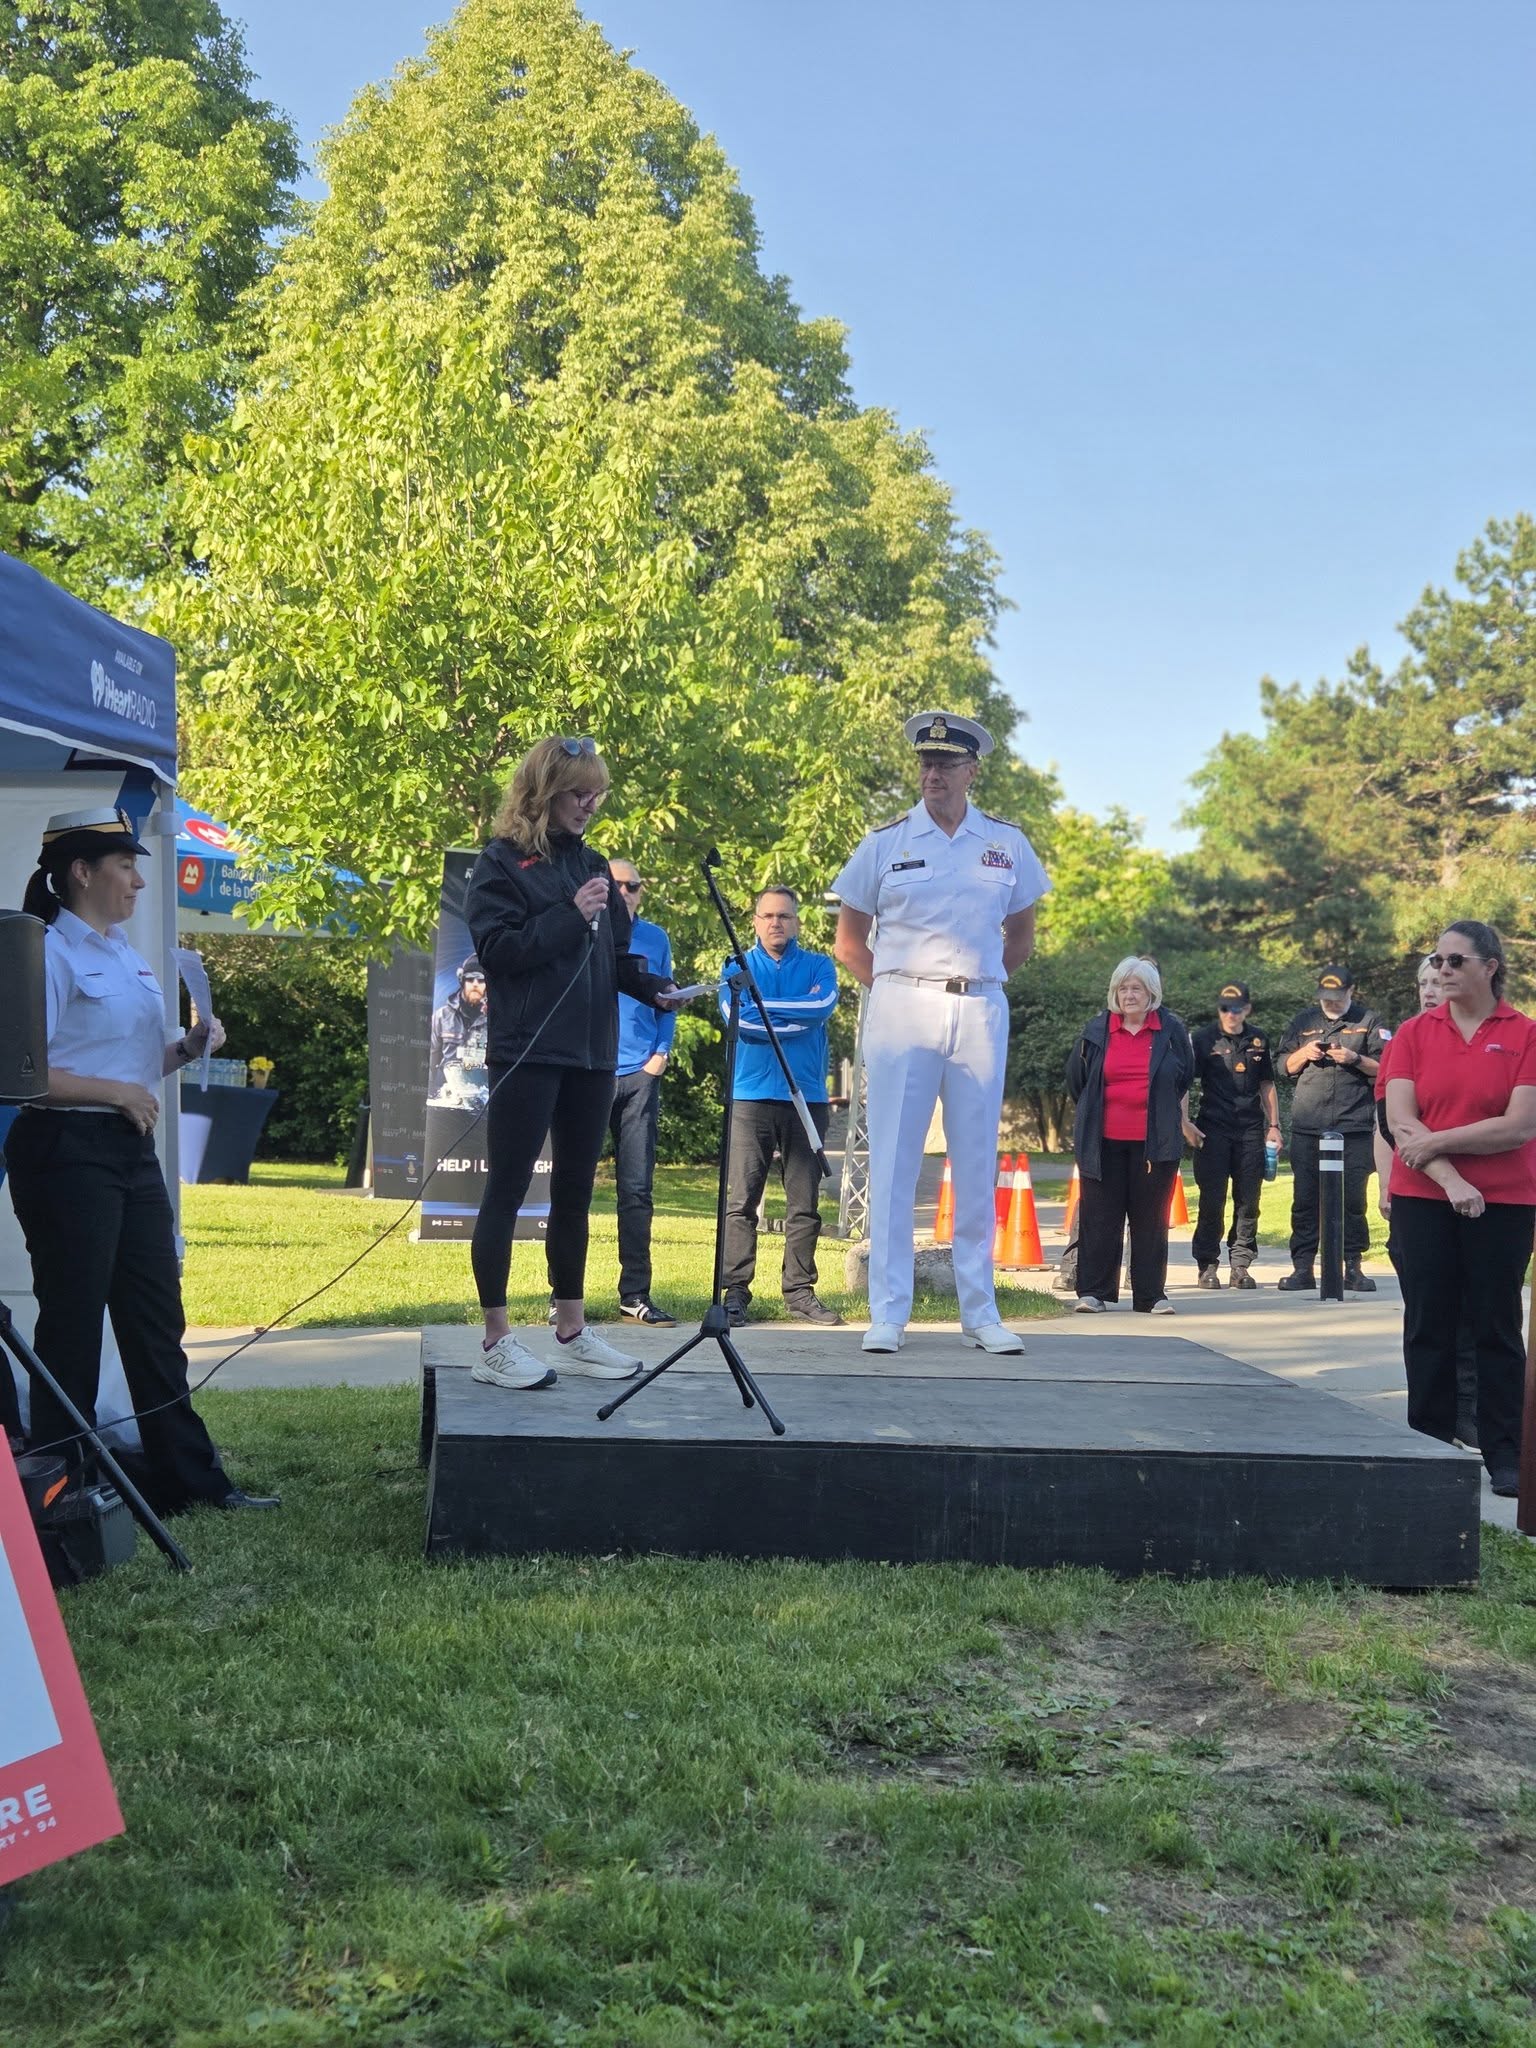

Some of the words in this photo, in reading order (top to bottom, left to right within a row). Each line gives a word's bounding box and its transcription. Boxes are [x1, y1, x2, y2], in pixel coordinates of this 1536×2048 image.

[104, 674, 157, 729] iHeartRADIO
[219, 881, 232, 896] de
[233, 882, 242, 897] la
[436, 1159, 471, 1172] HELP
